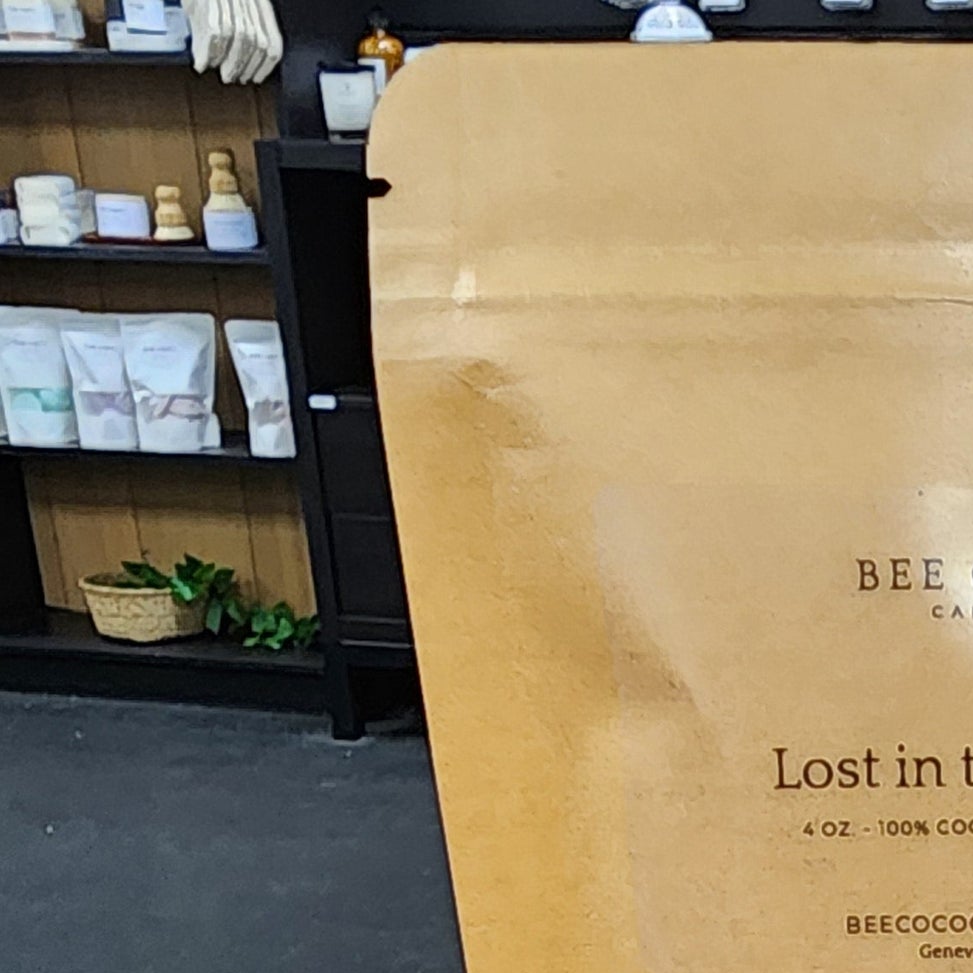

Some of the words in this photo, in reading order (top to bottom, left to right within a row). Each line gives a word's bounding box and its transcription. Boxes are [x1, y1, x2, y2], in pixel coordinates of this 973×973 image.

[856, 558, 944, 591] BEE
[773, 747, 881, 790] Lost
[895, 743, 947, 788] in
[802, 821, 814, 837] 4
[878, 820, 930, 837] 100%
